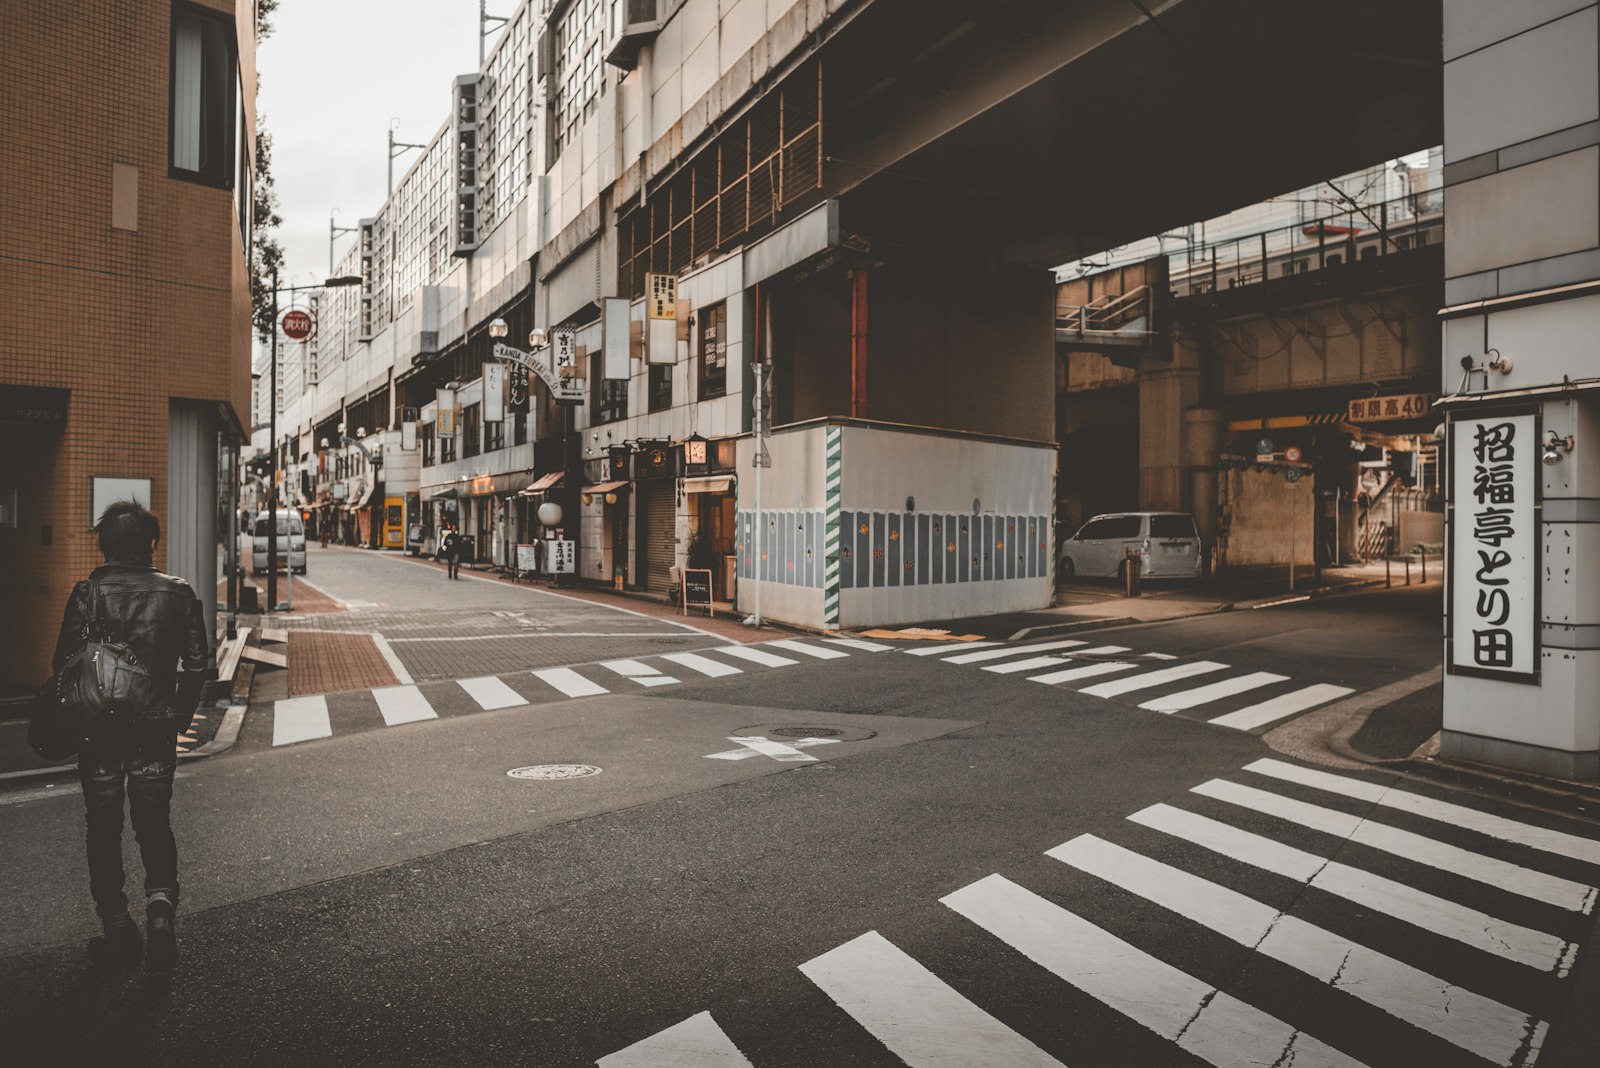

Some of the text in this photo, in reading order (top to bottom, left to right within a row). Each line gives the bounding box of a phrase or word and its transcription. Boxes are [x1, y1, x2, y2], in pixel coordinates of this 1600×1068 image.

[284, 318, 310, 331] 消火栓
[499, 347, 521, 360] KANDA
[523, 355, 546, 374] FUREAI
[1473, 422, 1516, 668] 招福亭とり田
